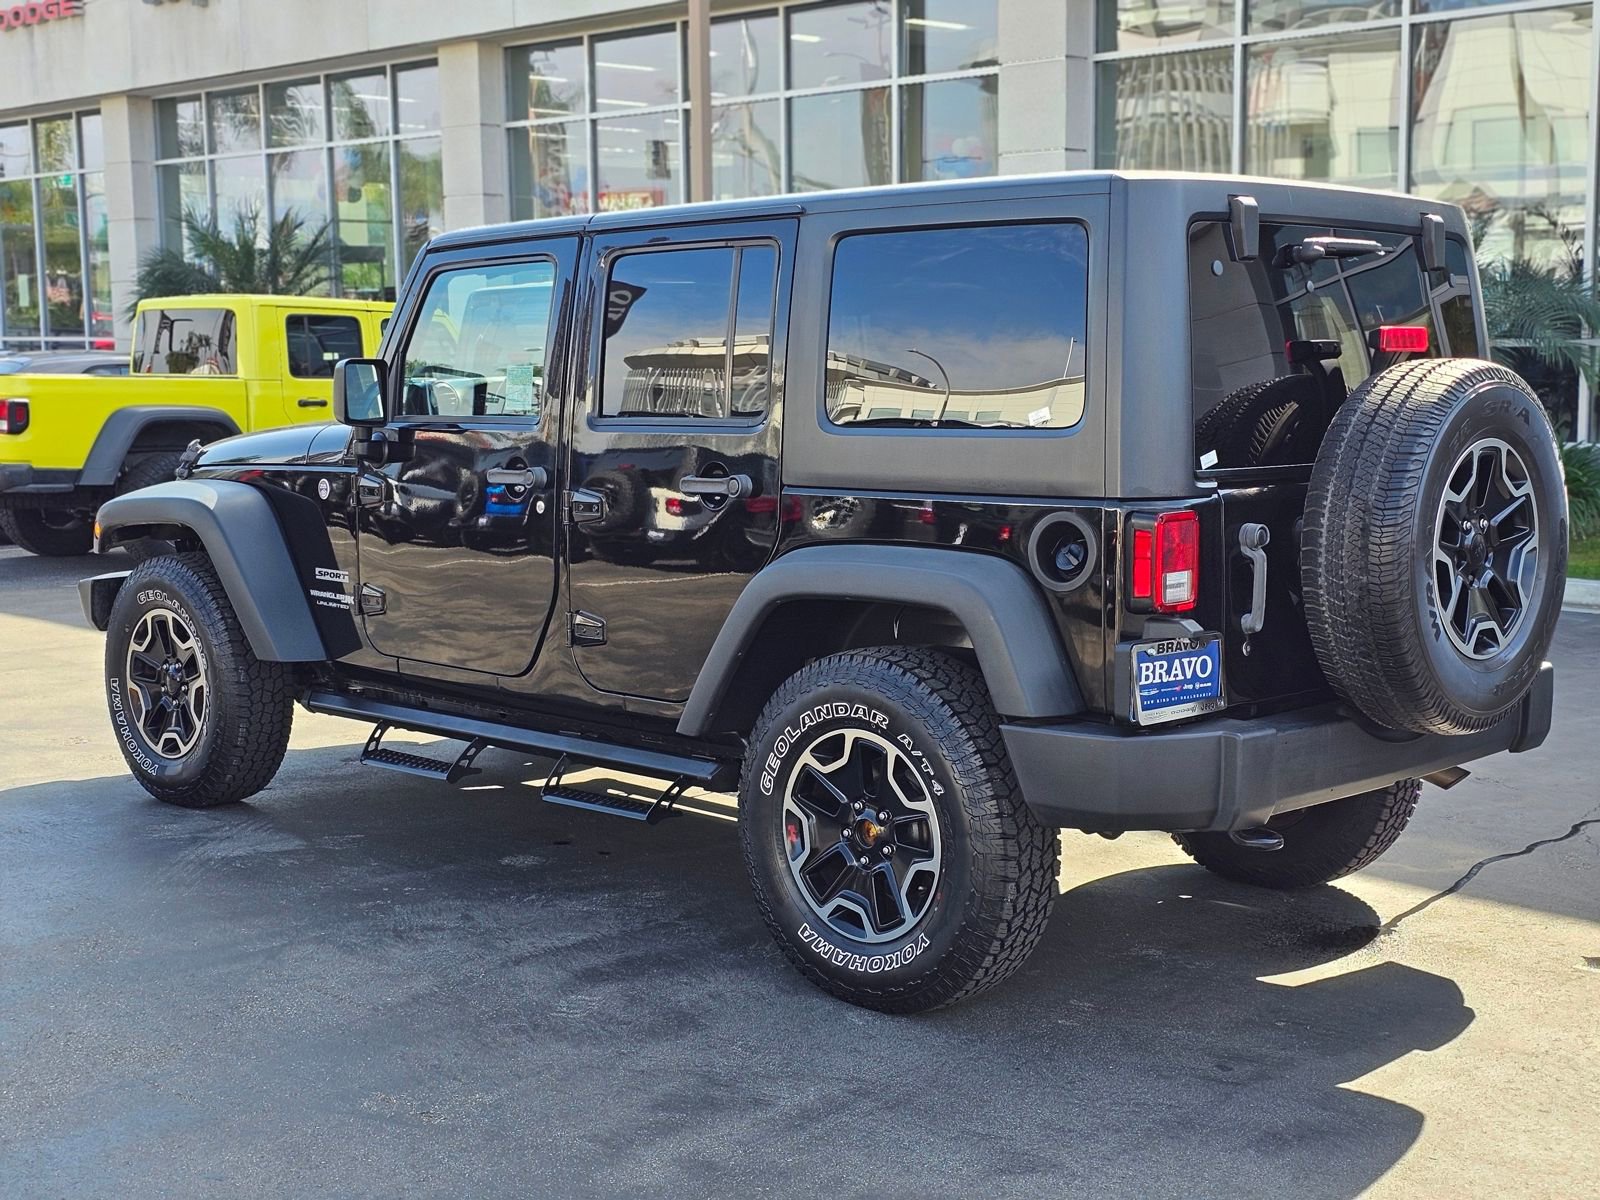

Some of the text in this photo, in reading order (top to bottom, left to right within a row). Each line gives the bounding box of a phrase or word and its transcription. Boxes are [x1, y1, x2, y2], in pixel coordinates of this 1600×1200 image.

[318, 570, 348, 580] SPORT
[310, 589, 345, 600] WRANGLER
[316, 600, 349, 609] UNLIMITED
[1157, 641, 1199, 654] BRAVO
[1139, 655, 1213, 686] BRAVO
[110, 678, 159, 776] YOKOHAMA
[760, 702, 889, 796] GEOLANDAR
[797, 922, 931, 974] YOKOHAMA
